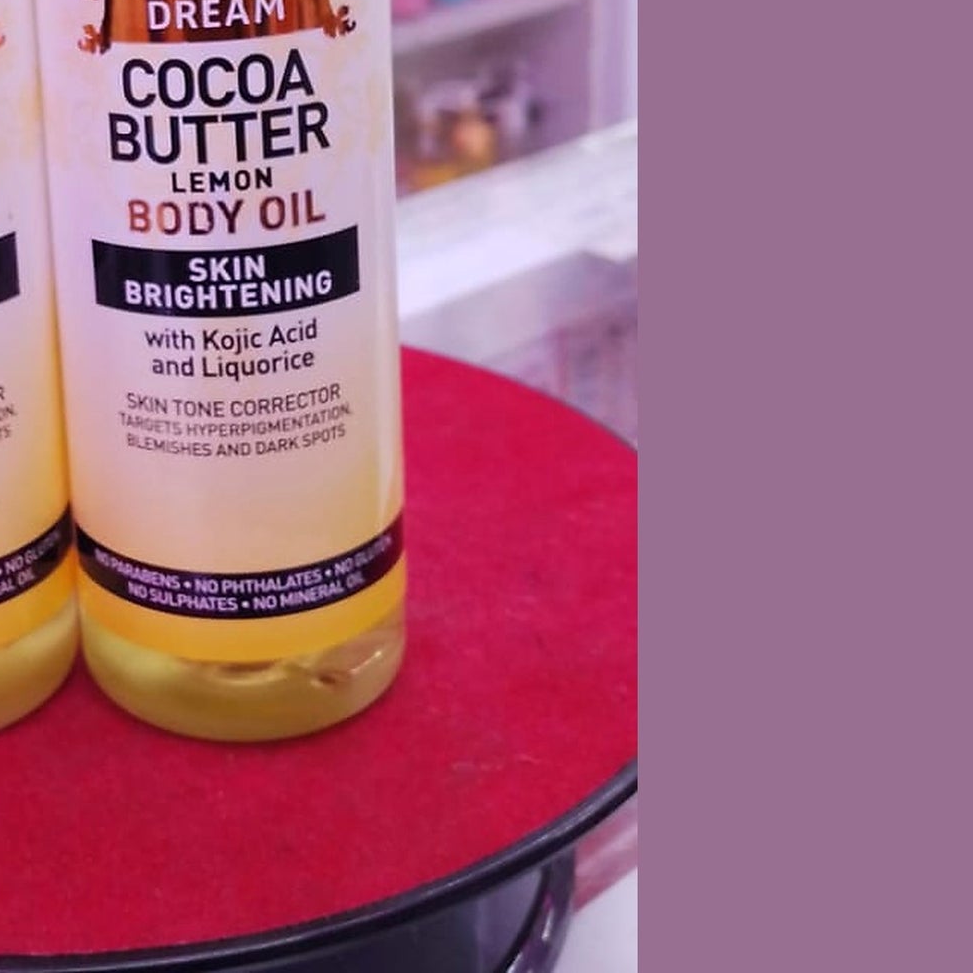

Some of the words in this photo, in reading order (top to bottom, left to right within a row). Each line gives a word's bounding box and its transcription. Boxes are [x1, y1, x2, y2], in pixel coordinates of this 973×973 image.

[122, 49, 314, 109] COCOA
[108, 101, 330, 164] BUTTER
[172, 167, 273, 193] LEMON
[127, 199, 244, 235] BODY
[259, 189, 325, 231] OIL
[188, 254, 266, 283] SKIN
[124, 270, 333, 310] BRIGHTENING
[144, 328, 195, 351] with
[203, 328, 262, 355] Kojic
[269, 318, 318, 347] Acid
[152, 357, 194, 377] and
[202, 350, 315, 382] Liquorice
[127, 392, 168, 414] SKIN
[174, 399, 225, 418] TONE
[230, 383, 341, 418] CORRECTOR
[118, 412, 182, 436] TARGETS
[127, 433, 212, 457] BLEMISHES
[216, 442, 251, 457] AND
[255, 436, 299, 455] DARK
[302, 423, 346, 448] SPOTS
[111, 557, 180, 590] PARABENS
[194, 579, 218, 594] NO
[221, 569, 322, 594] PHTHALATES
[128, 581, 147, 598] NO
[149, 588, 238, 611] SULPHATES
[253, 596, 277, 611] NO
[280, 579, 345, 608] MINERAL
